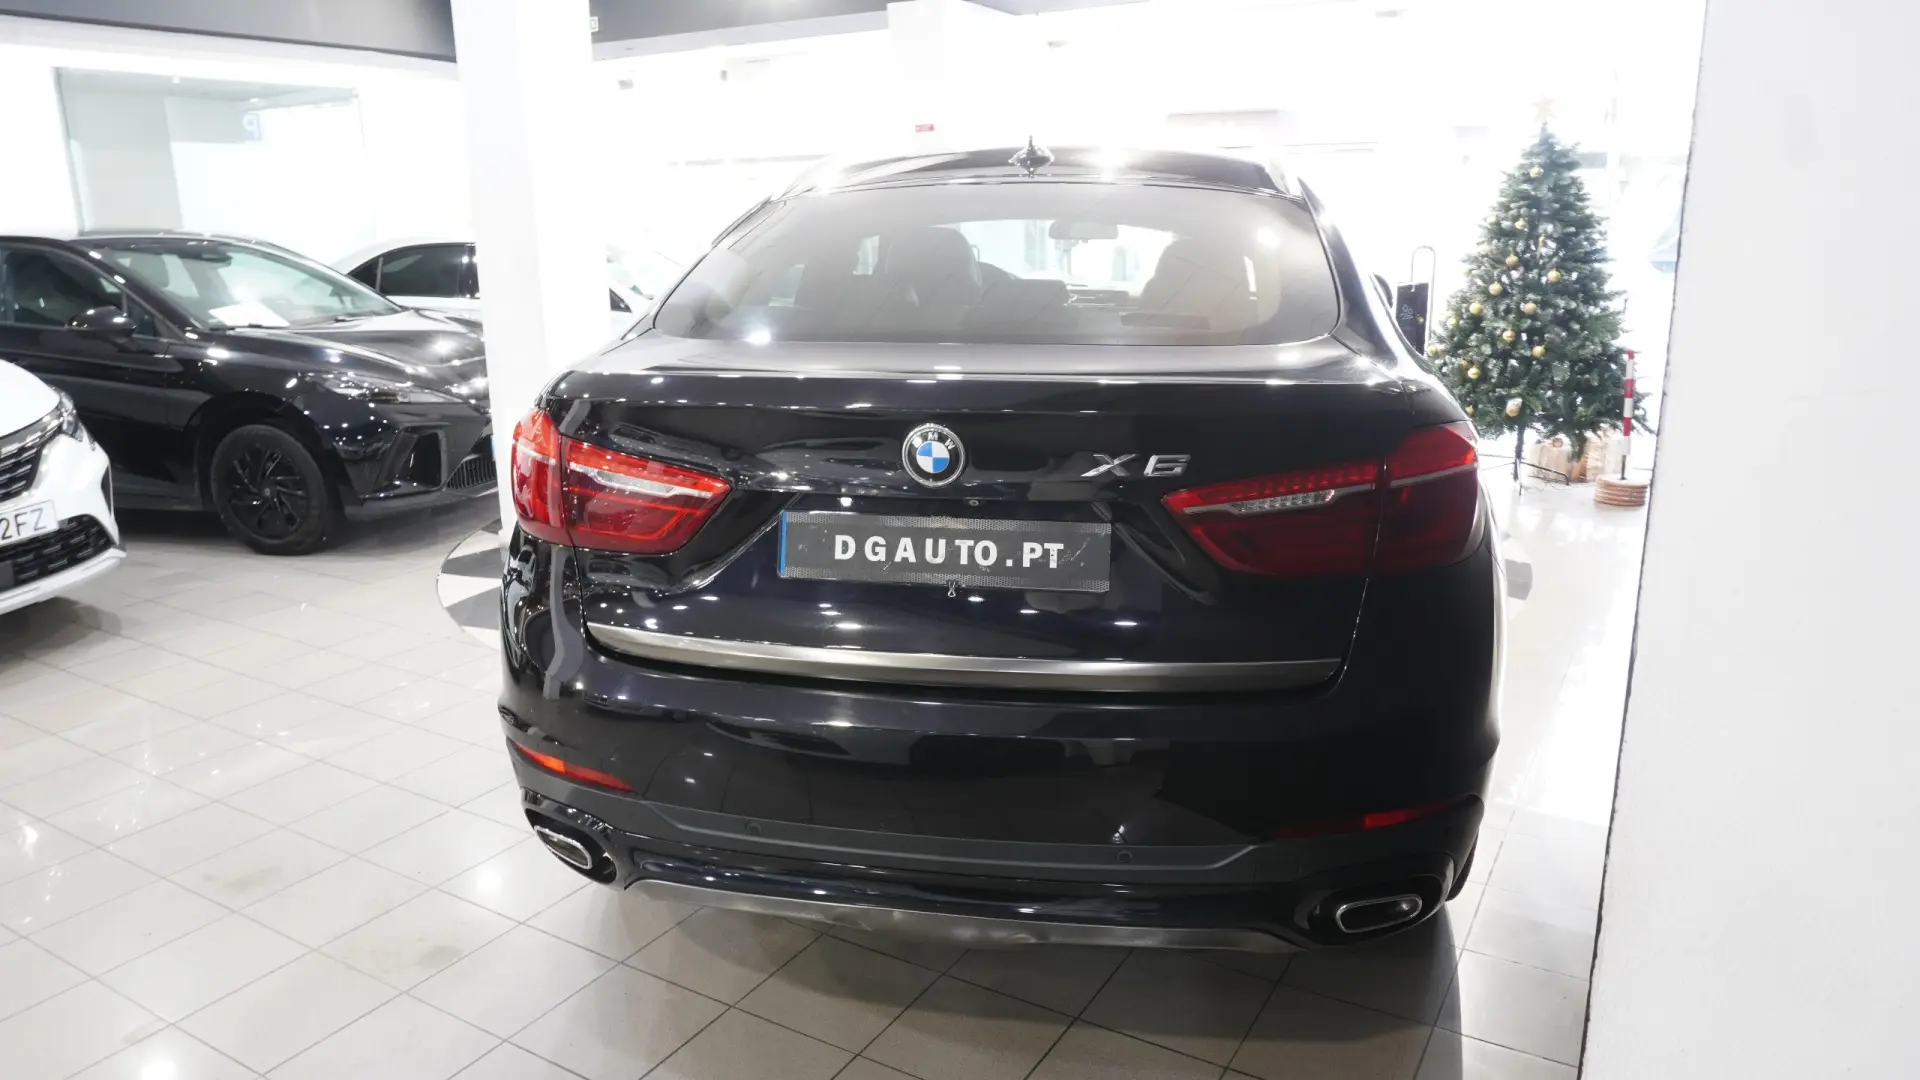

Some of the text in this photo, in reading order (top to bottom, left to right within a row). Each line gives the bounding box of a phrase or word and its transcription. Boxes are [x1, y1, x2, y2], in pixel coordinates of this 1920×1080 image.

[911, 431, 956, 450] BMW
[1080, 453, 1192, 477] X6
[0, 507, 48, 541] 2FZ
[834, 534, 1064, 569] DGAUTO.PT
